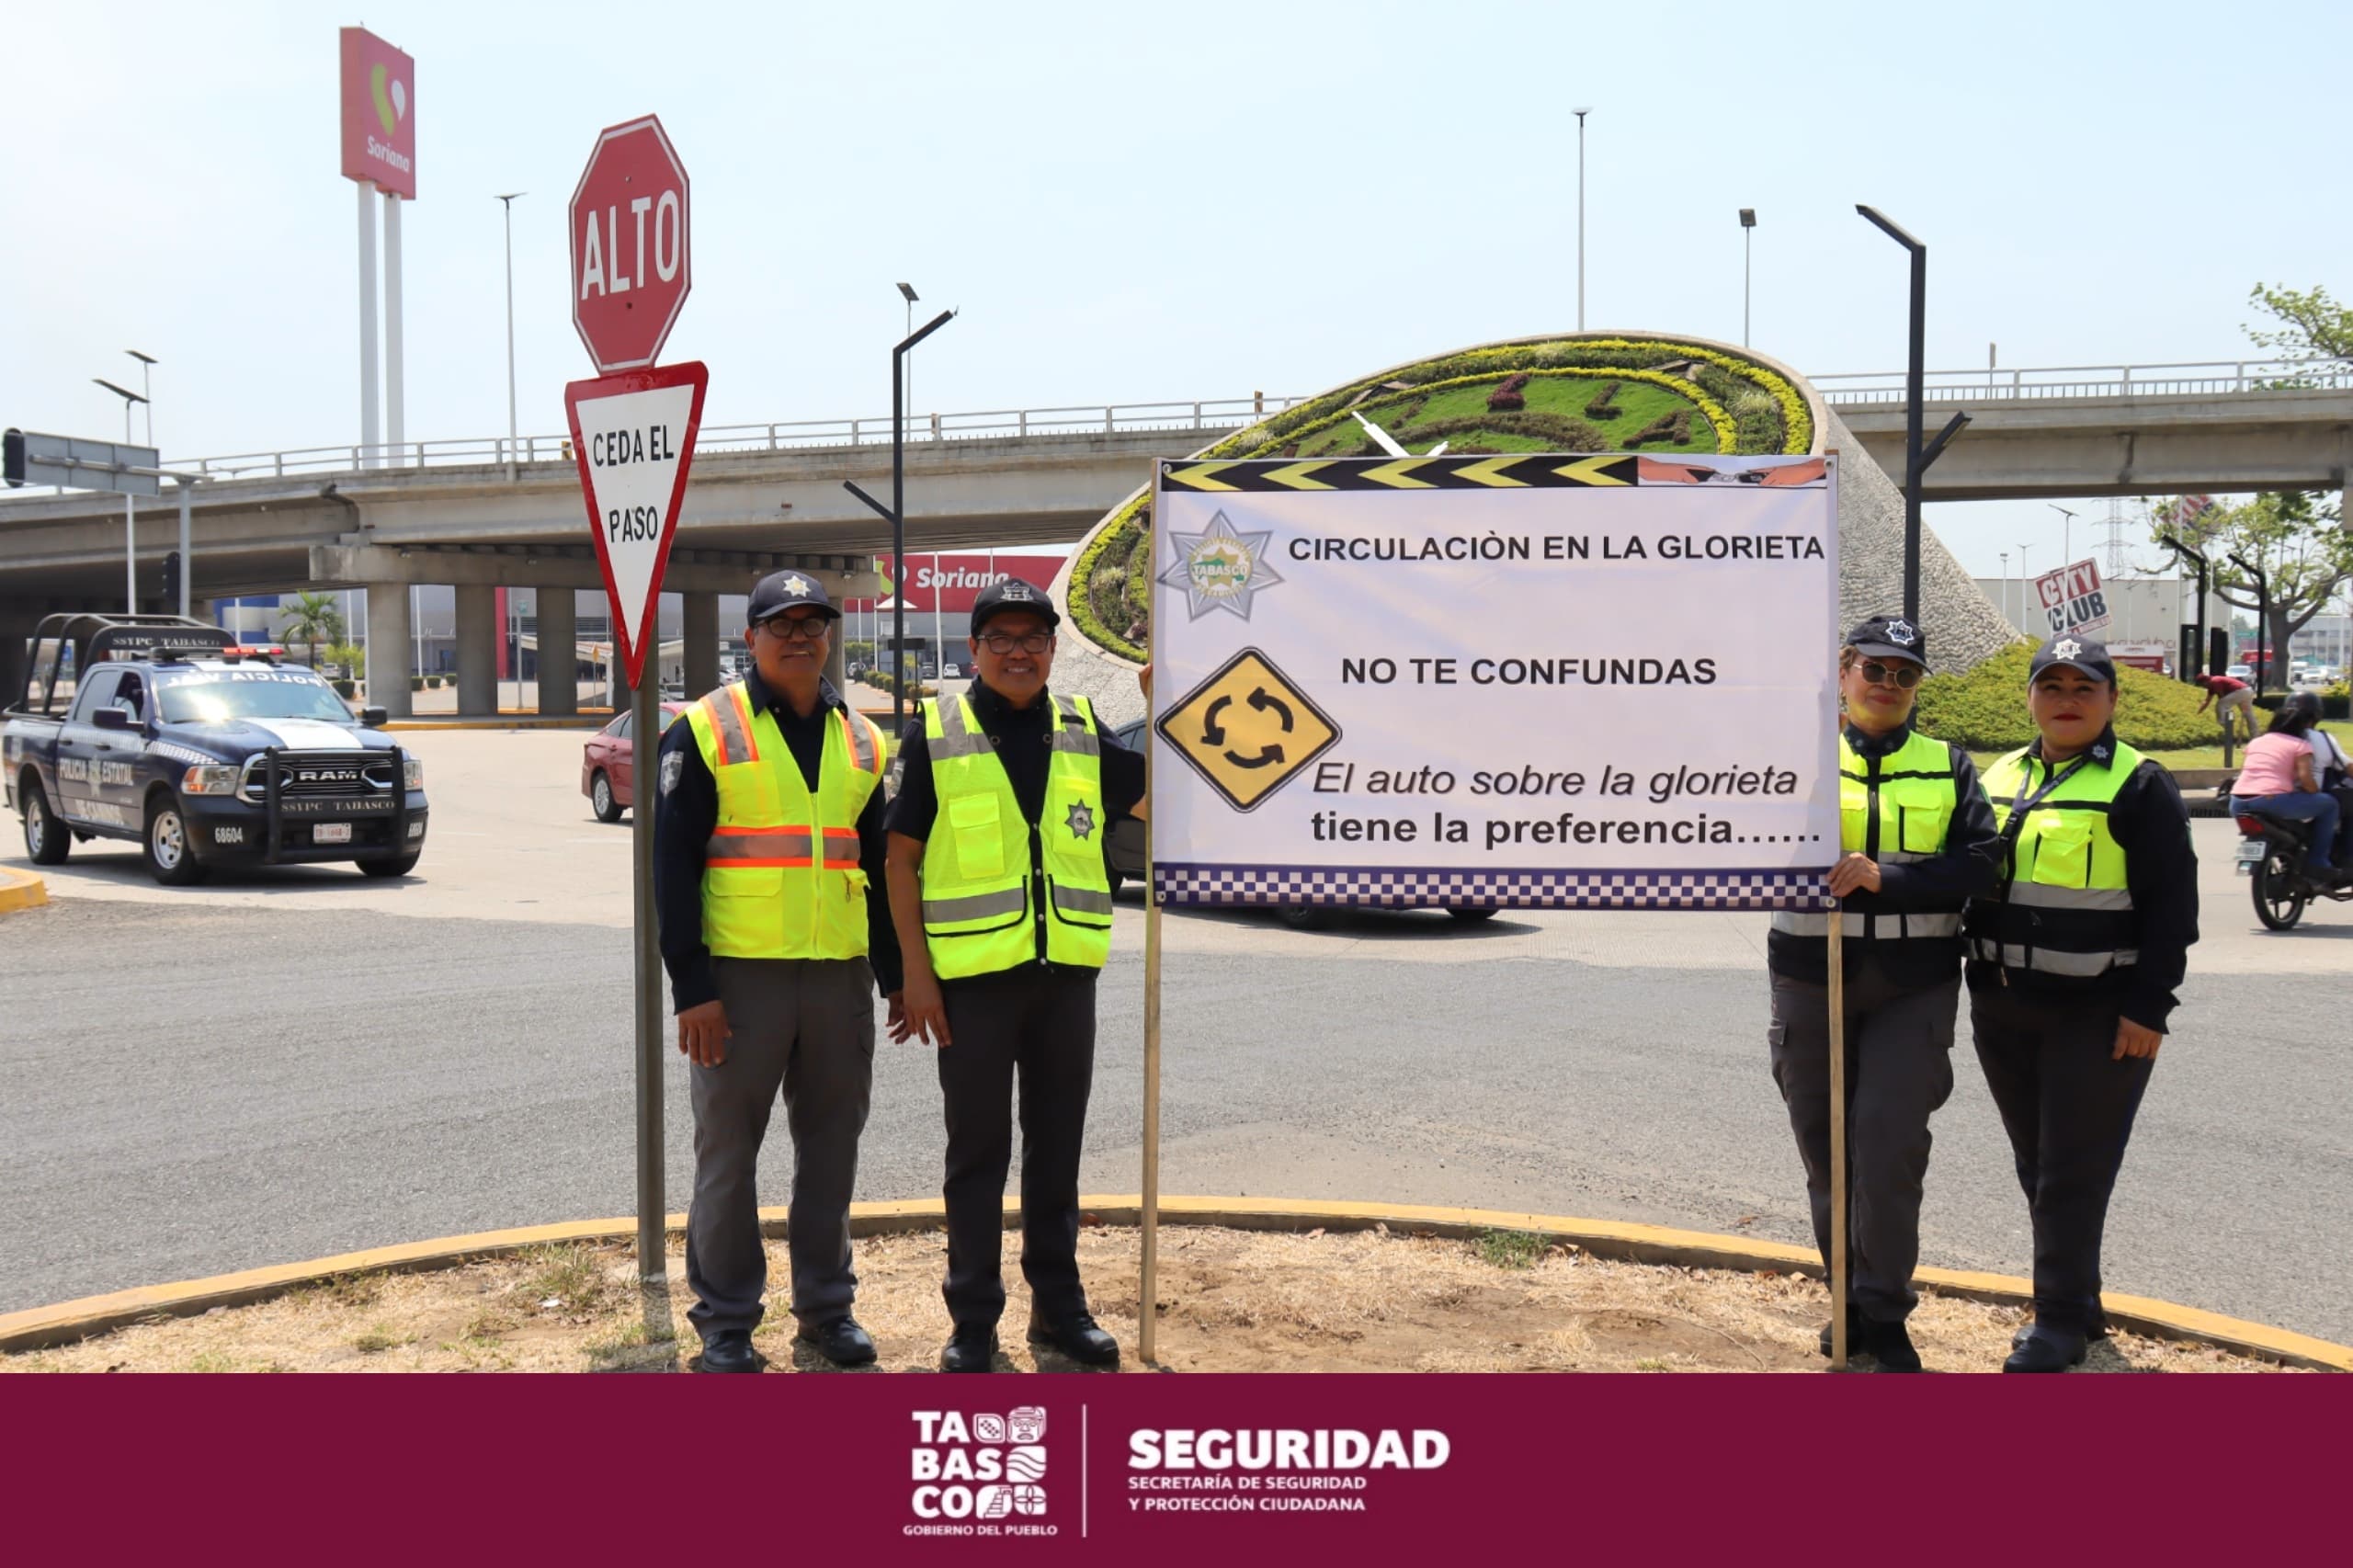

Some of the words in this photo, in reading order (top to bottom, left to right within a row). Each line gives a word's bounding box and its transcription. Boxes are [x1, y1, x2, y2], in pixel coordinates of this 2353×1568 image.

[367, 134, 410, 173] Soriana
[581, 189, 679, 301] ALTO
[593, 429, 644, 467] CEDA
[650, 425, 674, 460] EL
[608, 506, 658, 542] PASO
[1289, 530, 1529, 561] CIRCULACIÒN
[1543, 536, 1589, 560] EN
[1603, 535, 1648, 560] LA
[1657, 535, 1825, 560] GLORIETA
[1193, 564, 1248, 576] TABASCO
[2040, 563, 2094, 605] CITY
[2048, 592, 2108, 631] CLUB
[112, 637, 153, 646] SSYPC
[160, 637, 221, 647] TABASCO
[1342, 658, 1397, 685] NO
[1409, 658, 1458, 685] TE
[1471, 658, 1717, 686] CONFUNDAS
[299, 770, 358, 780] RAM
[1313, 762, 1355, 794] El
[1366, 765, 1456, 794] auto
[1470, 764, 1586, 796] sobre
[1599, 764, 1635, 796] la
[1648, 764, 1798, 804] glorieta
[281, 801, 323, 812] SSYPC
[333, 800, 395, 812] TABASCO
[214, 826, 243, 843] 68604
[1311, 811, 1417, 842] tiene
[1434, 812, 1469, 843] la
